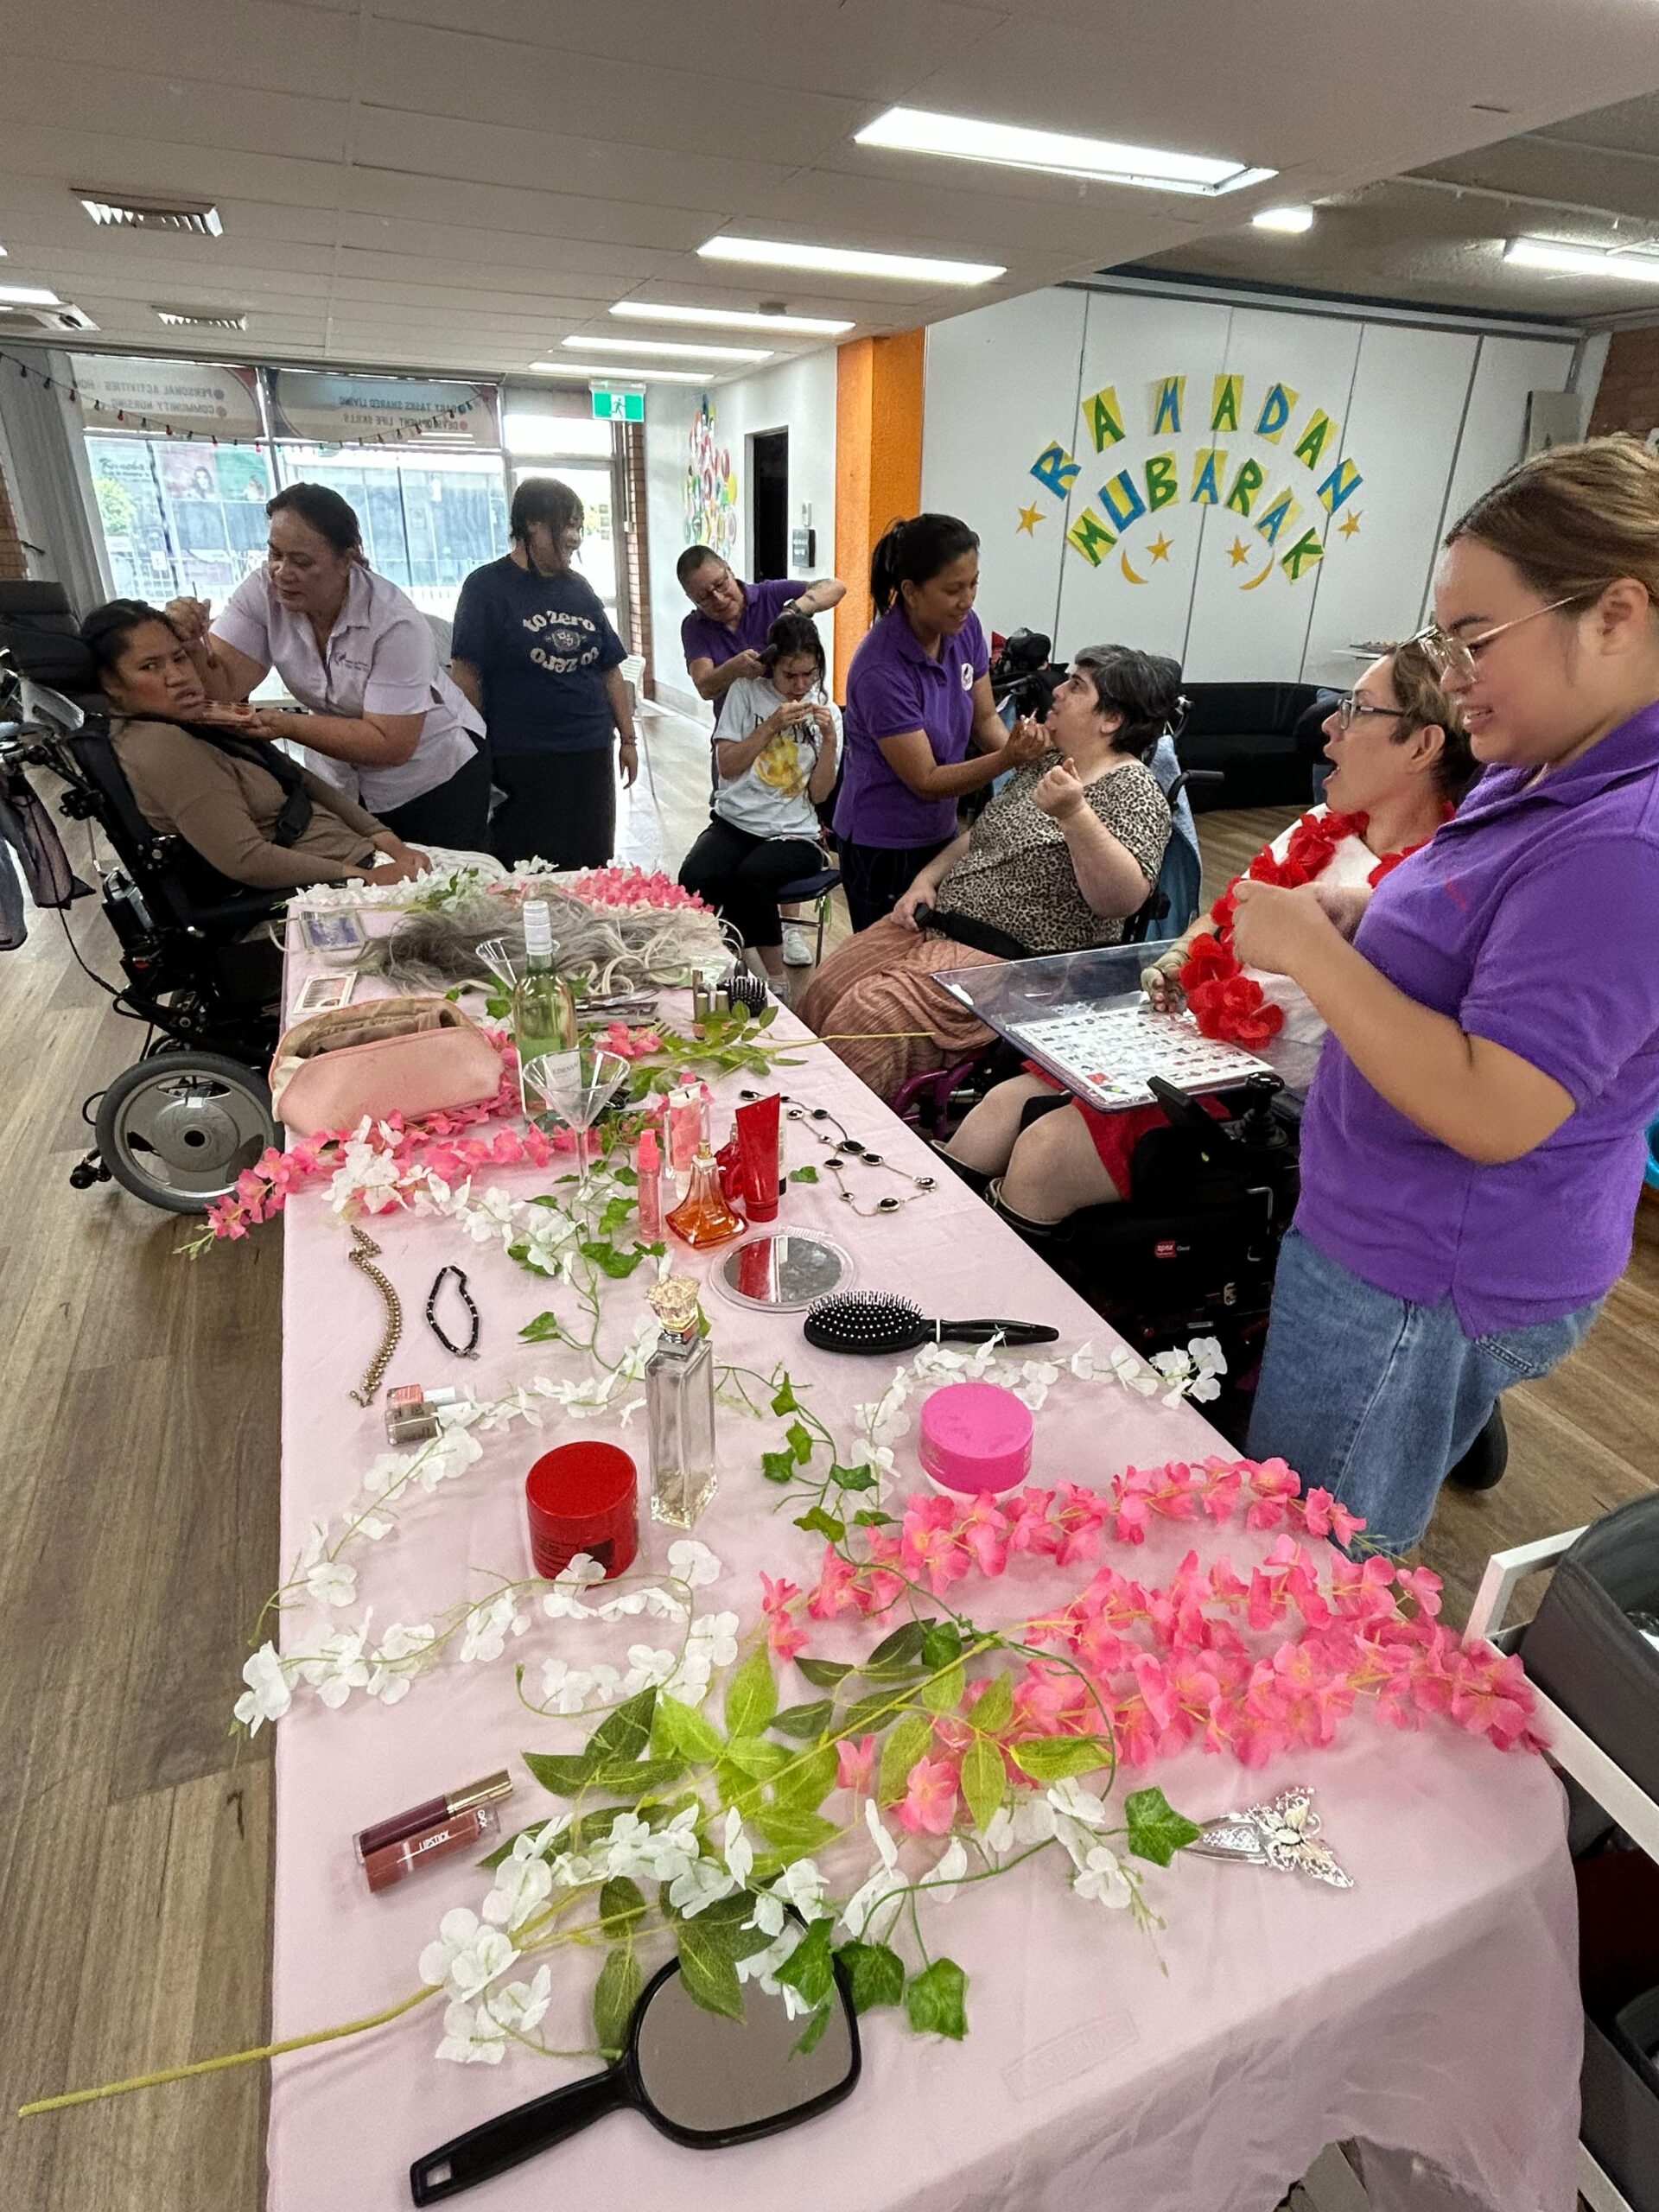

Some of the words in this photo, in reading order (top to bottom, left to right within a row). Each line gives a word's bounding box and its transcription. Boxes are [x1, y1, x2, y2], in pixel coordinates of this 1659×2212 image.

[1030, 374, 1363, 517] RAMADAN
[1066, 449, 1325, 582] MUBARAK
[522, 613, 548, 632] to
[546, 610, 596, 632] zero
[530, 647, 578, 673] zero
